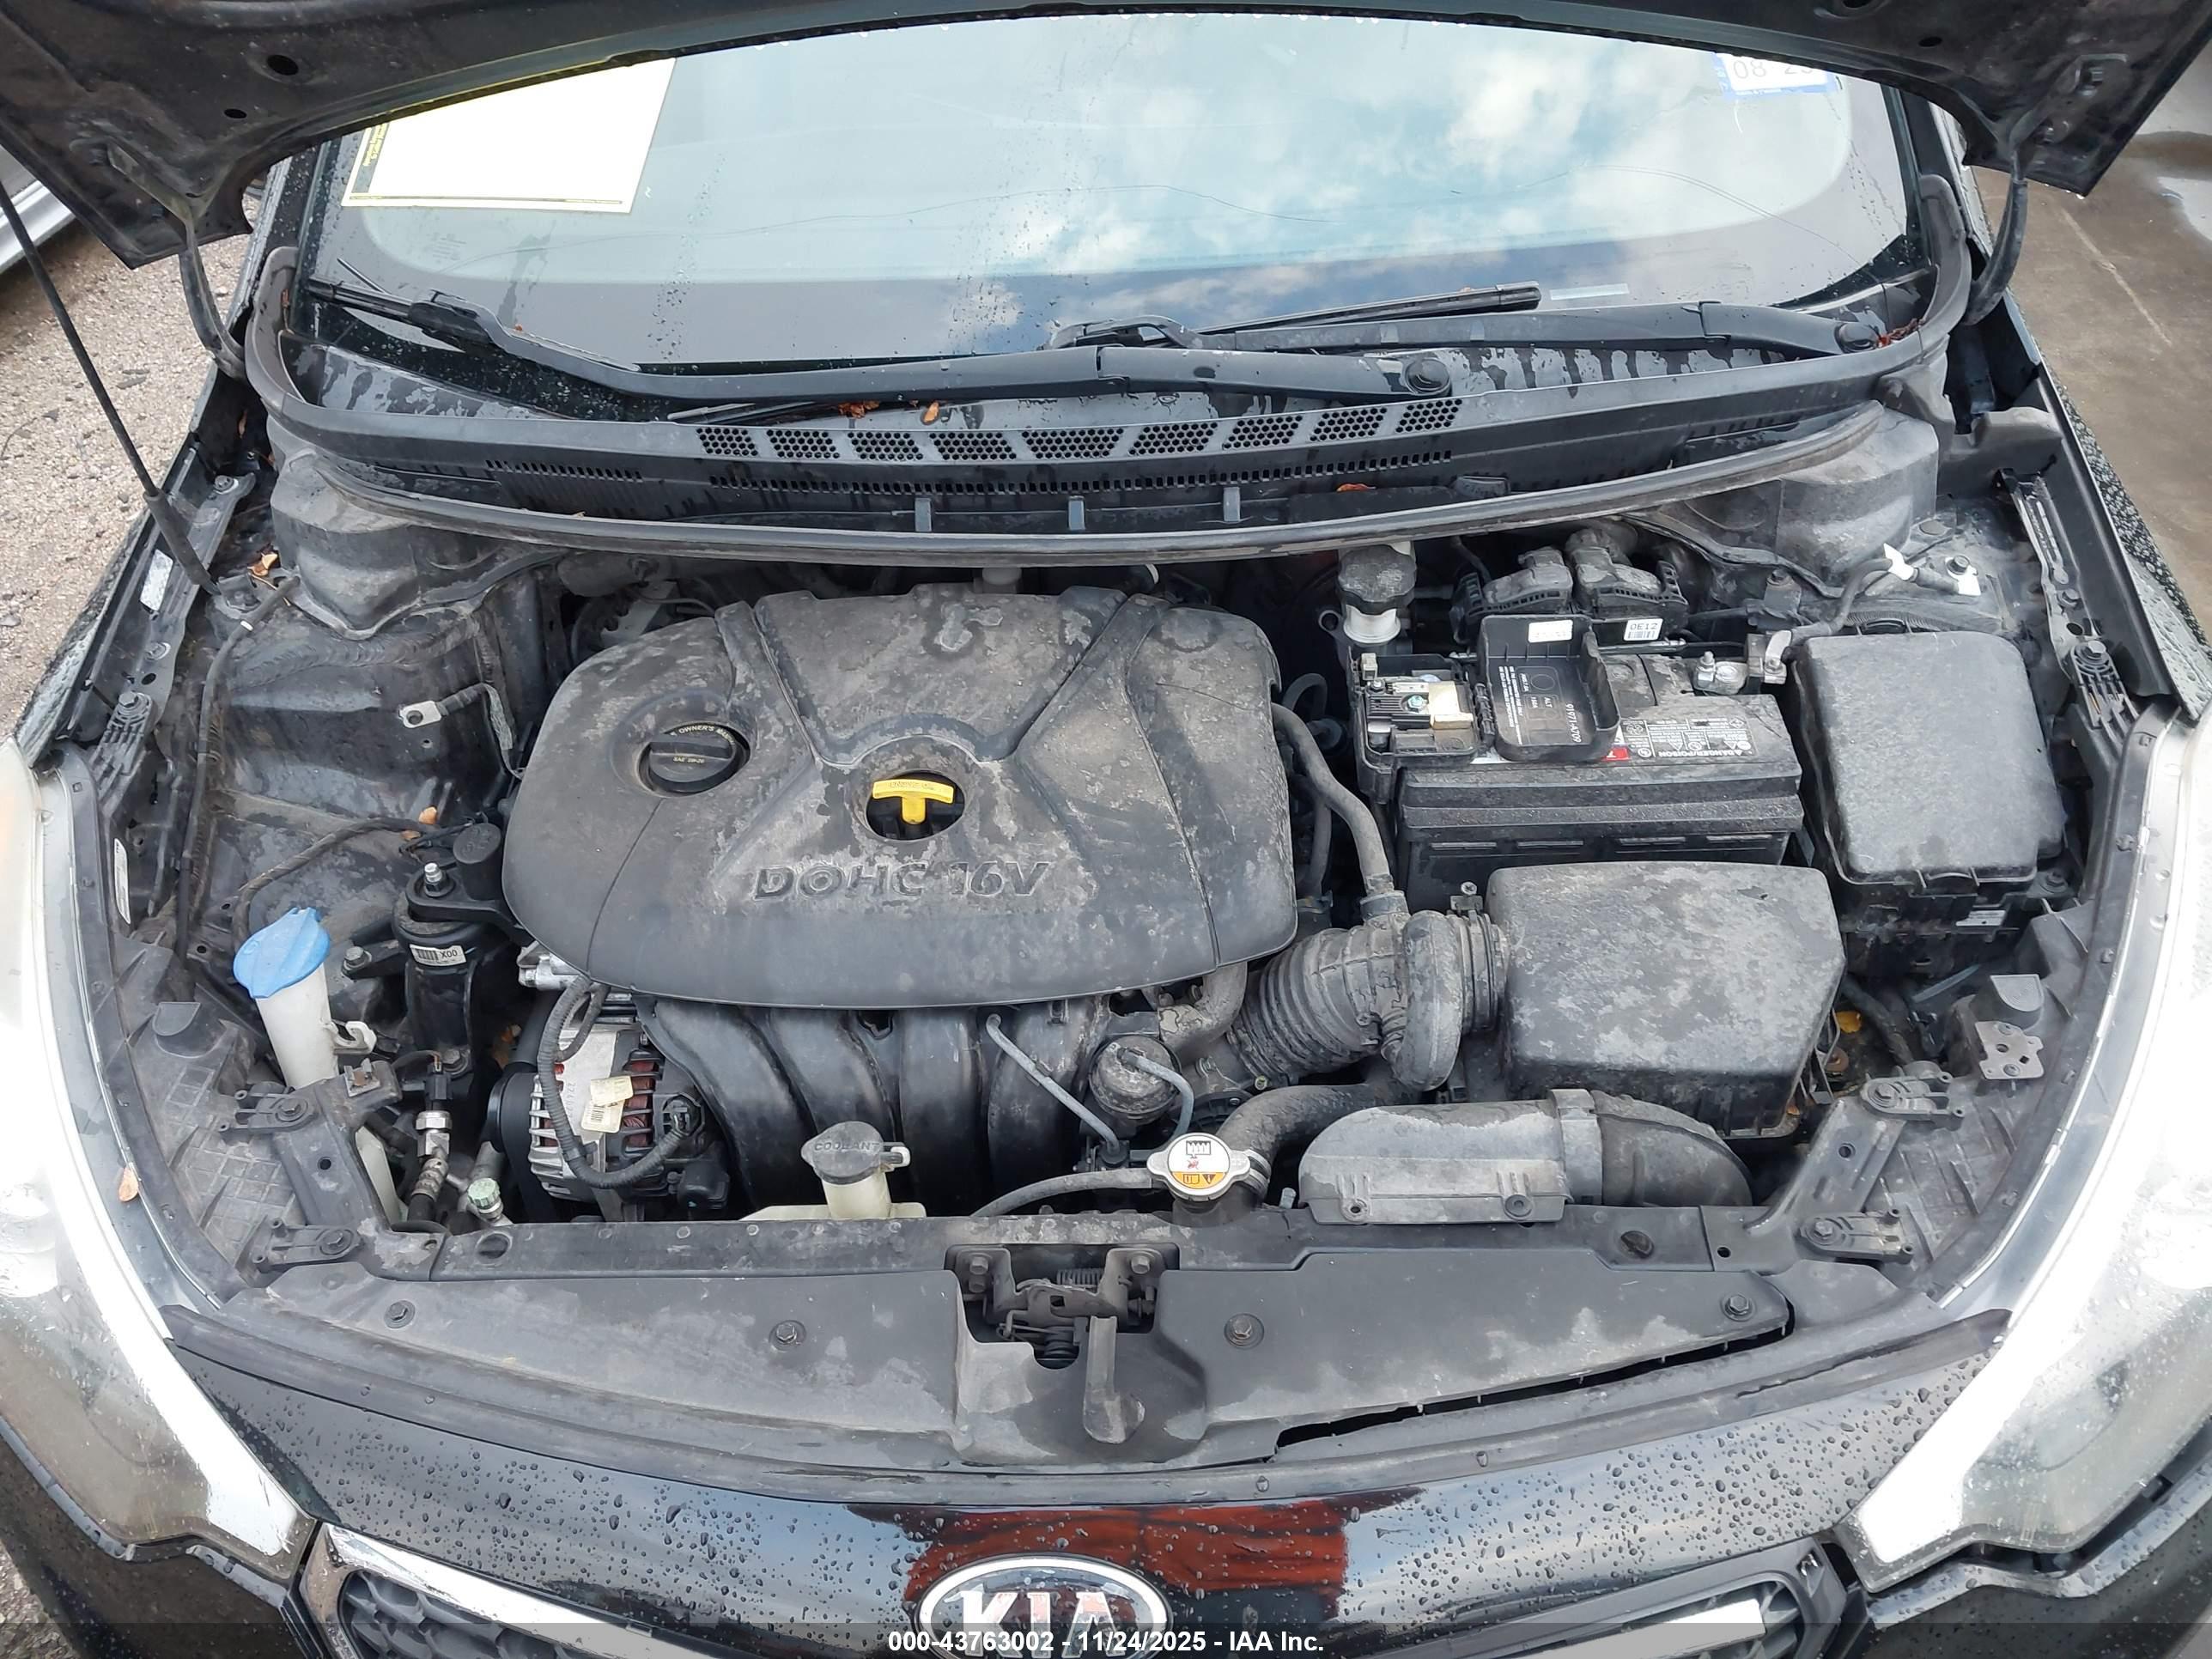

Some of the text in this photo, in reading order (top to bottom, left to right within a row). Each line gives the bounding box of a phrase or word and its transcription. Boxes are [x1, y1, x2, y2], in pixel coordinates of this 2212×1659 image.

[1733, 59, 1766, 79] 08
[1544, 696, 1553, 708] ALT
[678, 725, 715, 734] OWNER'S
[753, 860, 1050, 900] DOHC 16V
[814, 1141, 880, 1152] COOLANT
[961, 1589, 1127, 1658] KIA
